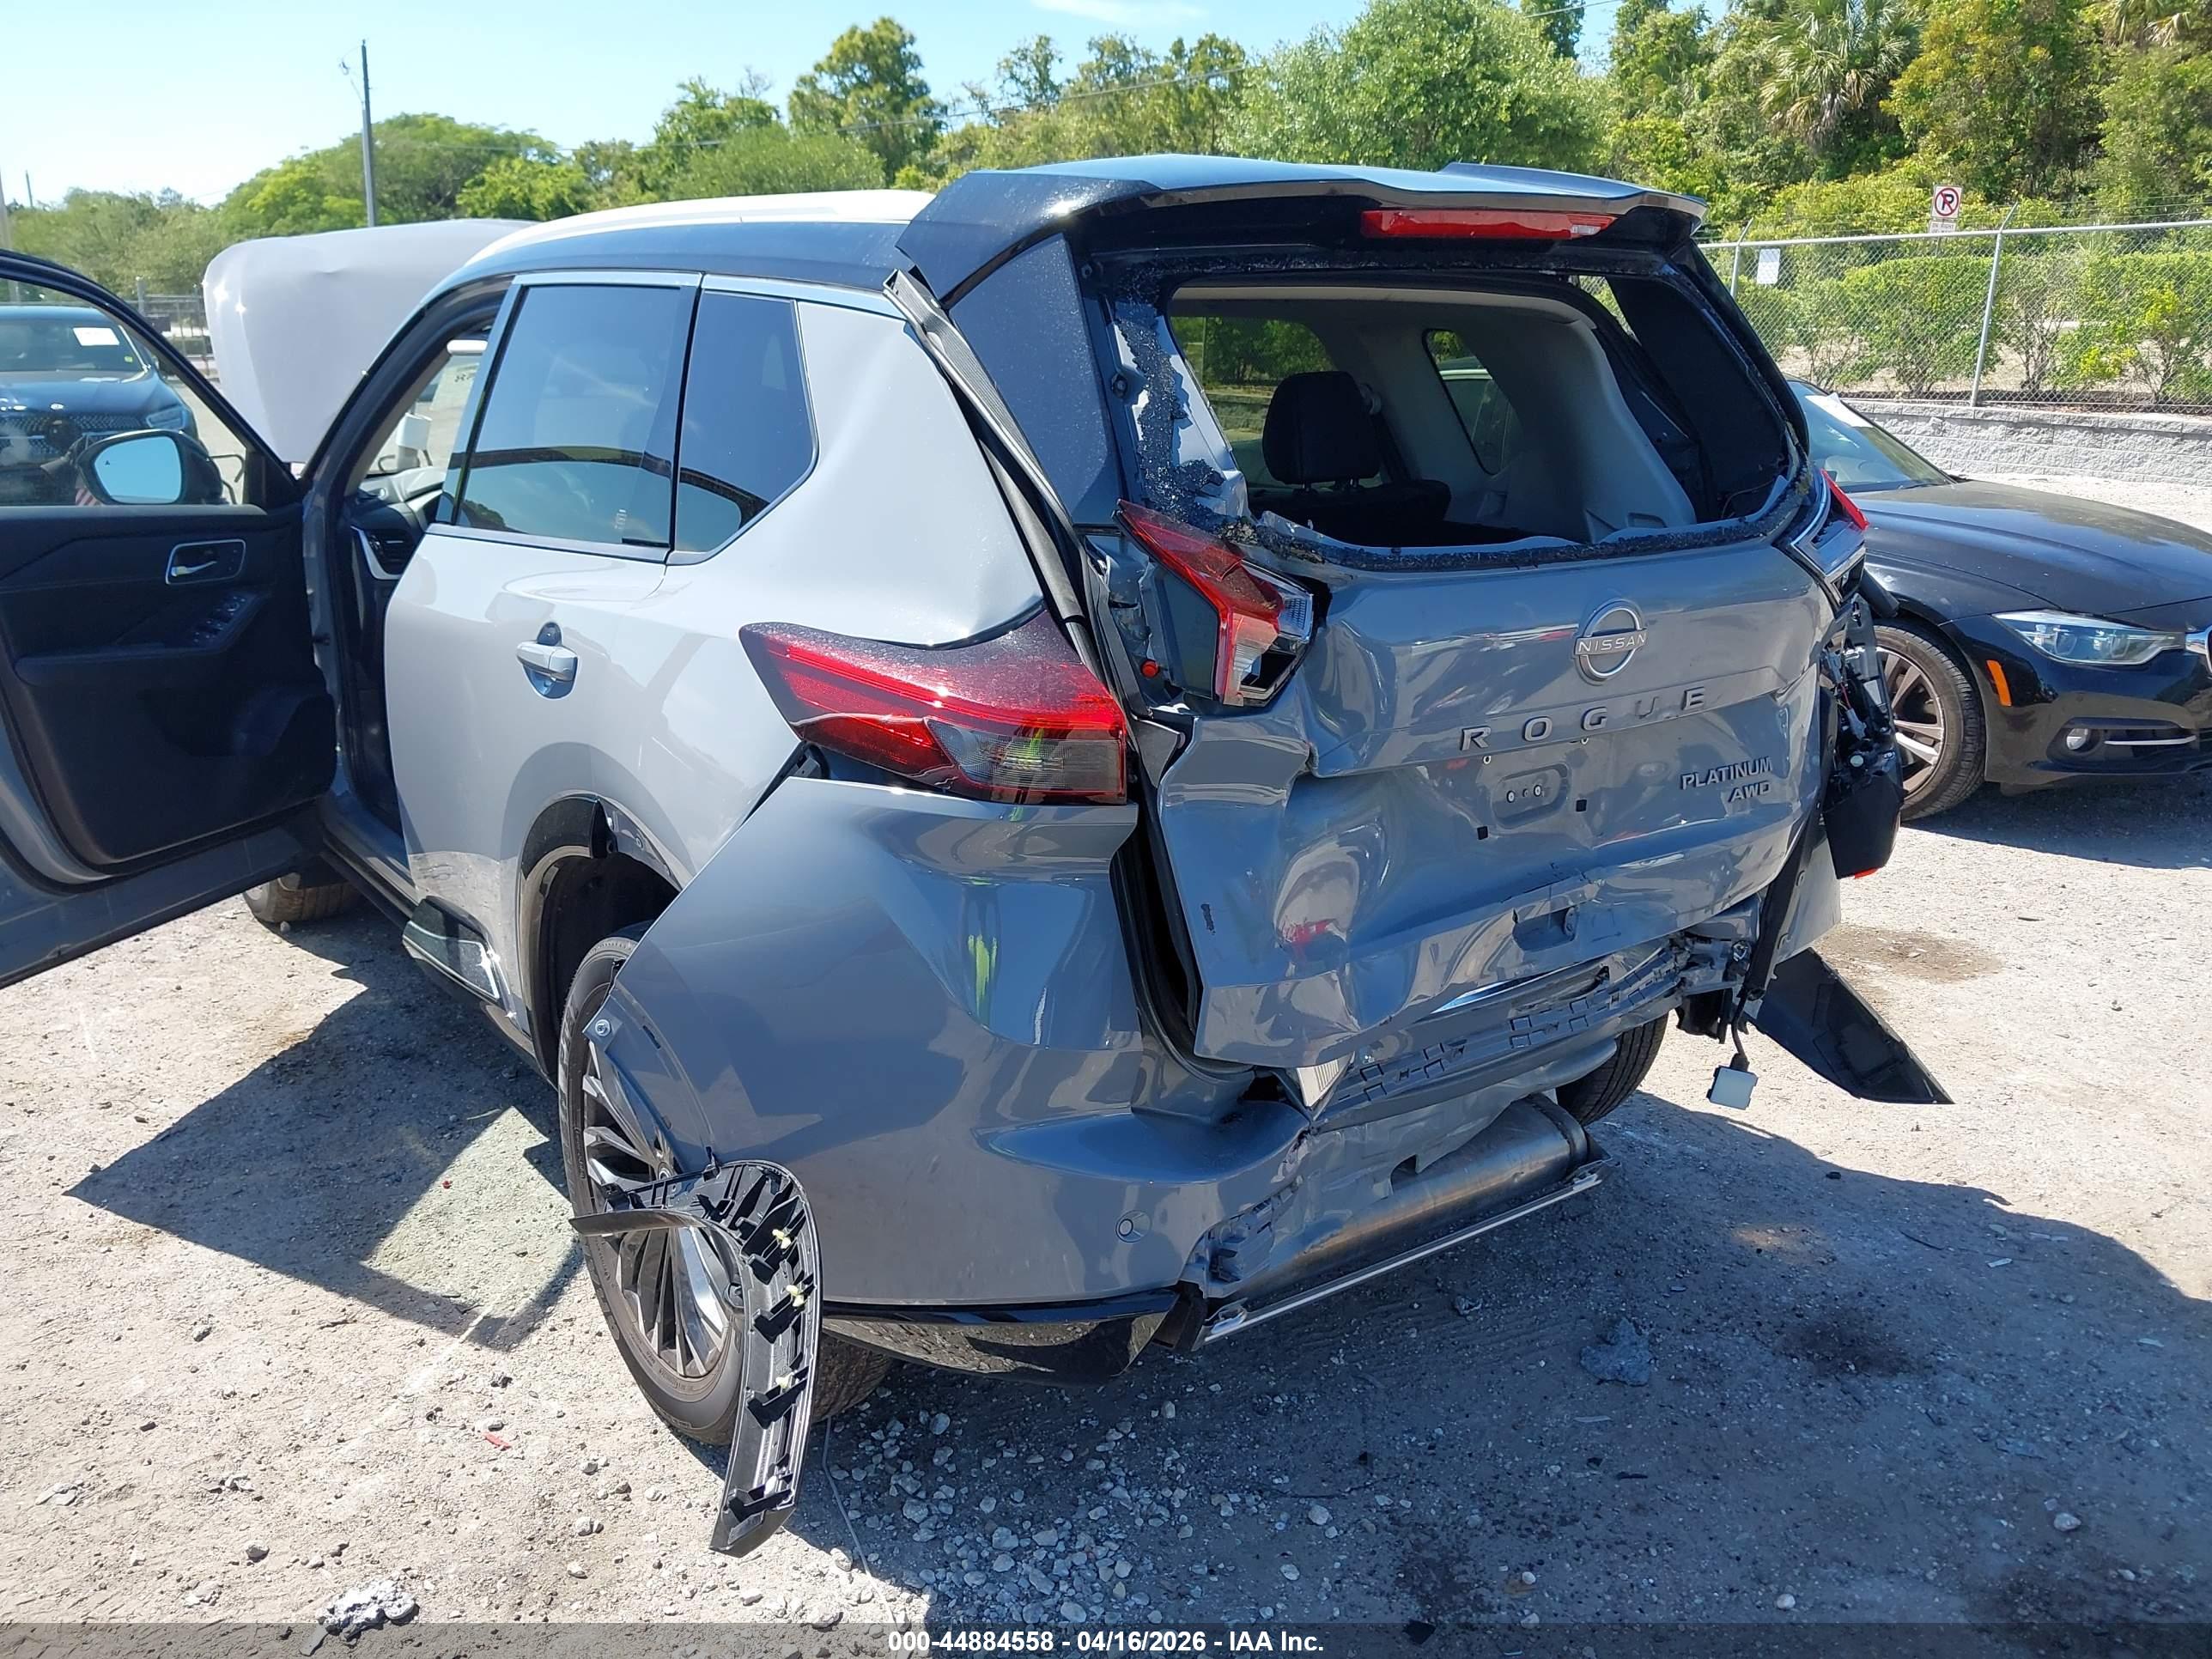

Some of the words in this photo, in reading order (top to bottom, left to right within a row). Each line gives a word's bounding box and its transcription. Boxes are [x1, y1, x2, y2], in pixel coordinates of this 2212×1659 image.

[1941, 193, 1954, 210] P
[1577, 633, 1647, 653] NISSAN
[1460, 687, 1706, 751] ROGUE
[1680, 757, 1773, 790] PLATINUM
[1728, 780, 1771, 803] AWD
